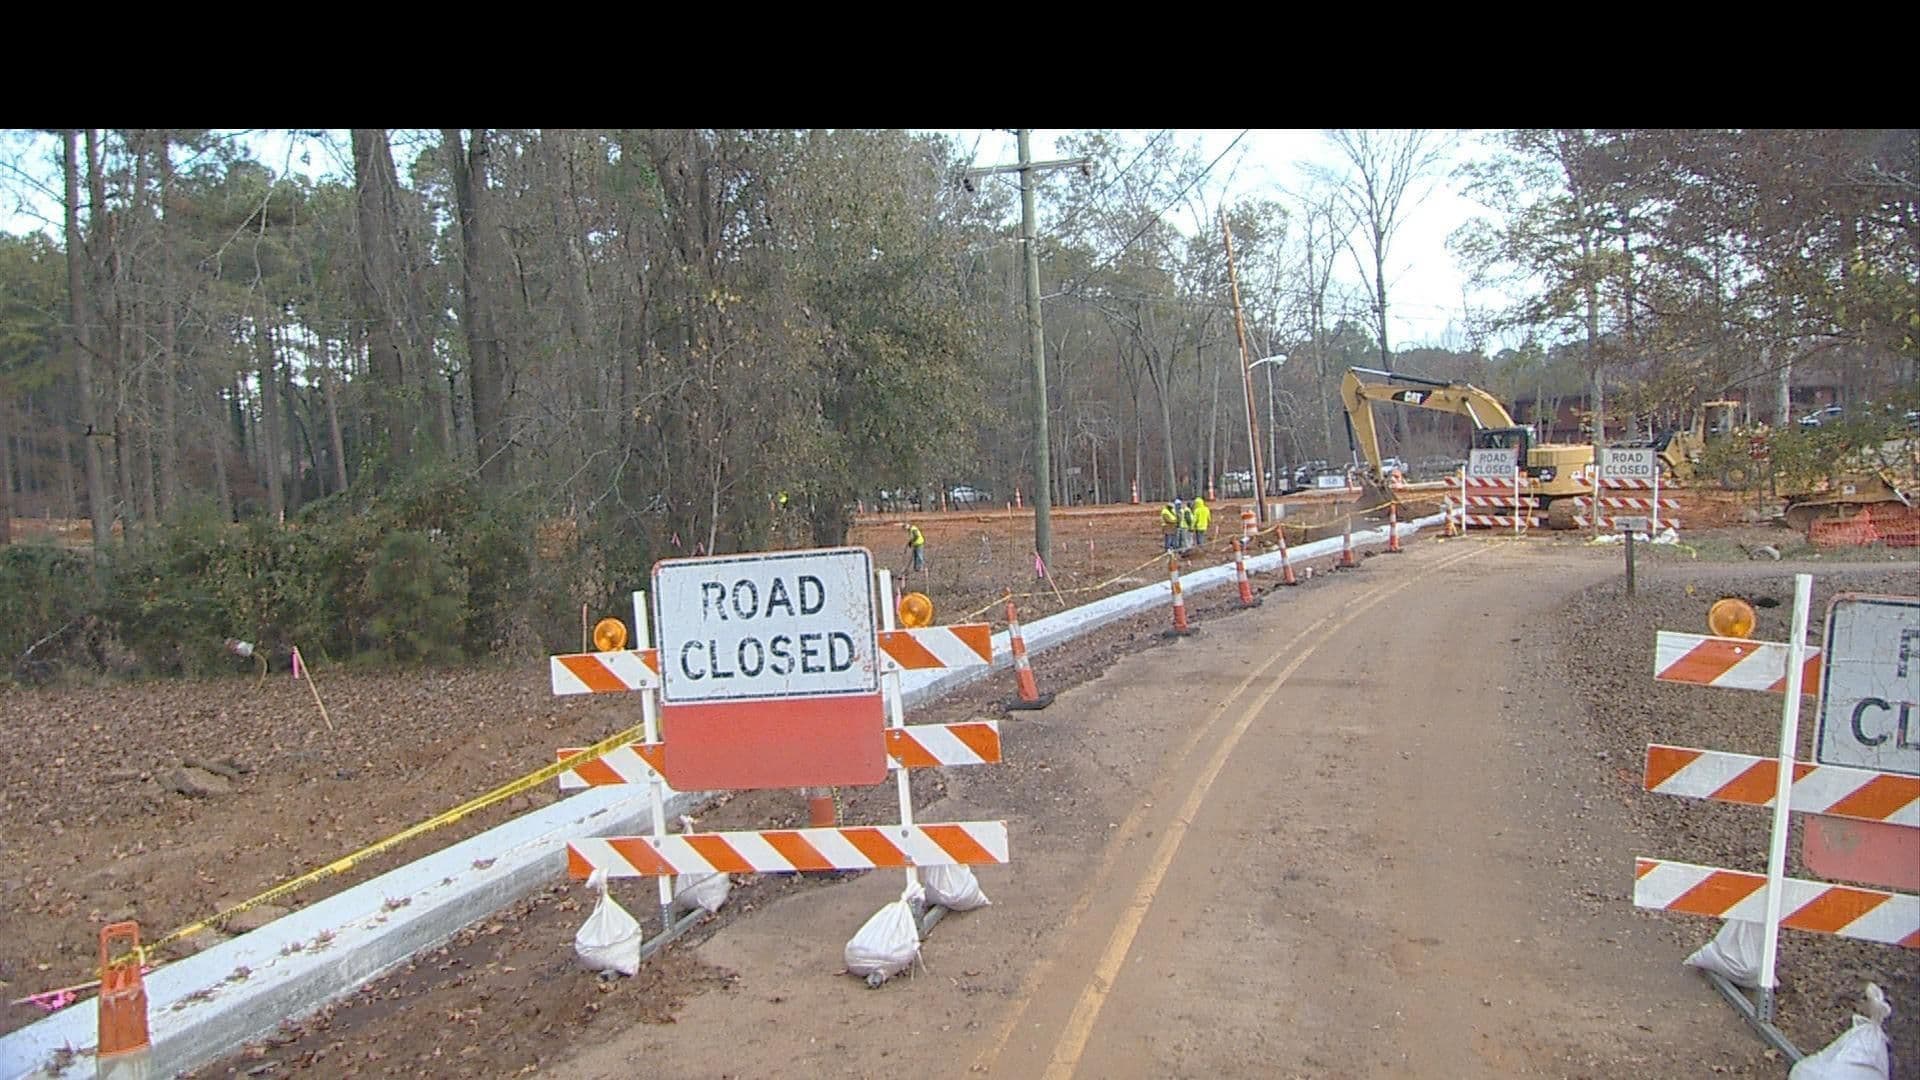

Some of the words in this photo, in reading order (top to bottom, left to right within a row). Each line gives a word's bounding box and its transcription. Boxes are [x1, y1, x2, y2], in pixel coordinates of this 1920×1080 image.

[1404, 390, 1423, 404] CAT
[1479, 453, 1507, 462] ROAD
[1612, 453, 1643, 463] ROAD
[1473, 465, 1512, 475] CLOSED
[1606, 465, 1649, 476] CLOSED
[702, 575, 825, 620] ROAD
[681, 632, 854, 680] CLOSED
